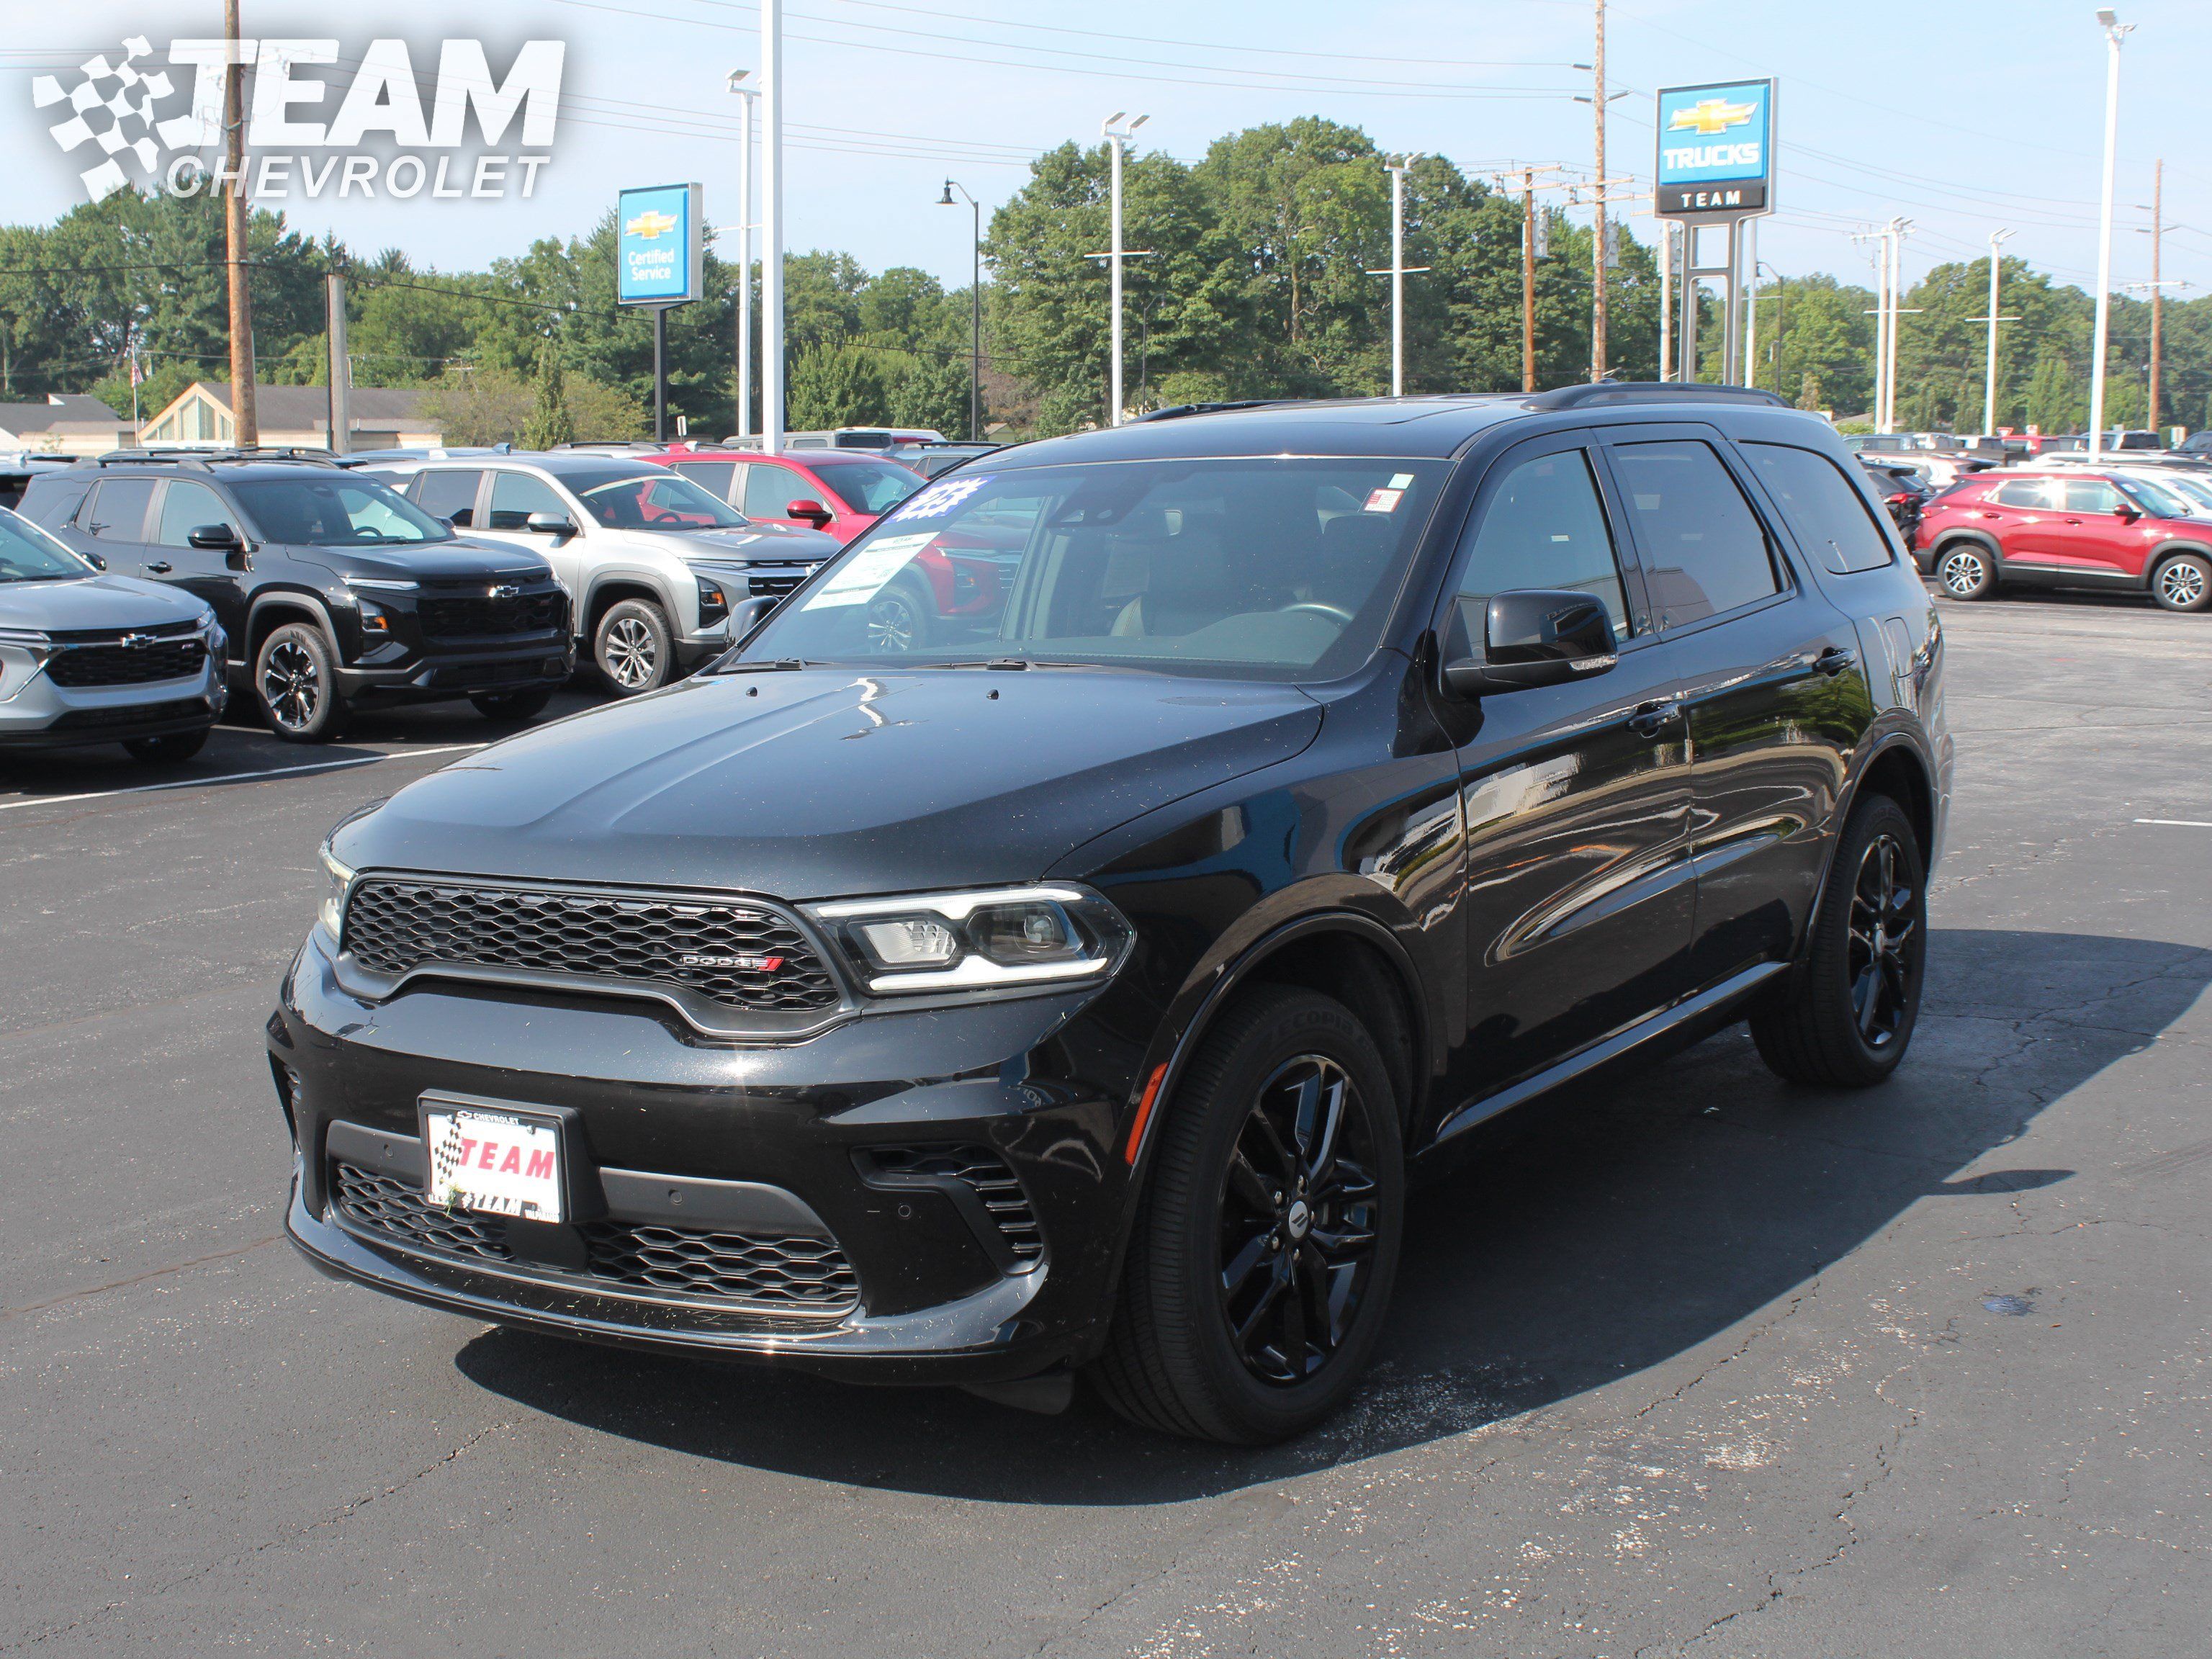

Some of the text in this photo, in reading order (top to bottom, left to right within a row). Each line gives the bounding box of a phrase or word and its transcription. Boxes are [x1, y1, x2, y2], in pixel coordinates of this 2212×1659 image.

[1663, 143, 1760, 170] TRUCKS
[1681, 190, 1741, 207] TEAM
[628, 248, 675, 266] Certified
[631, 265, 671, 281] Service
[683, 956, 769, 968] DODGE
[473, 1112, 520, 1125] CHEVROLET
[459, 1138, 554, 1179] TEAM
[472, 1192, 522, 1216] TEAM
